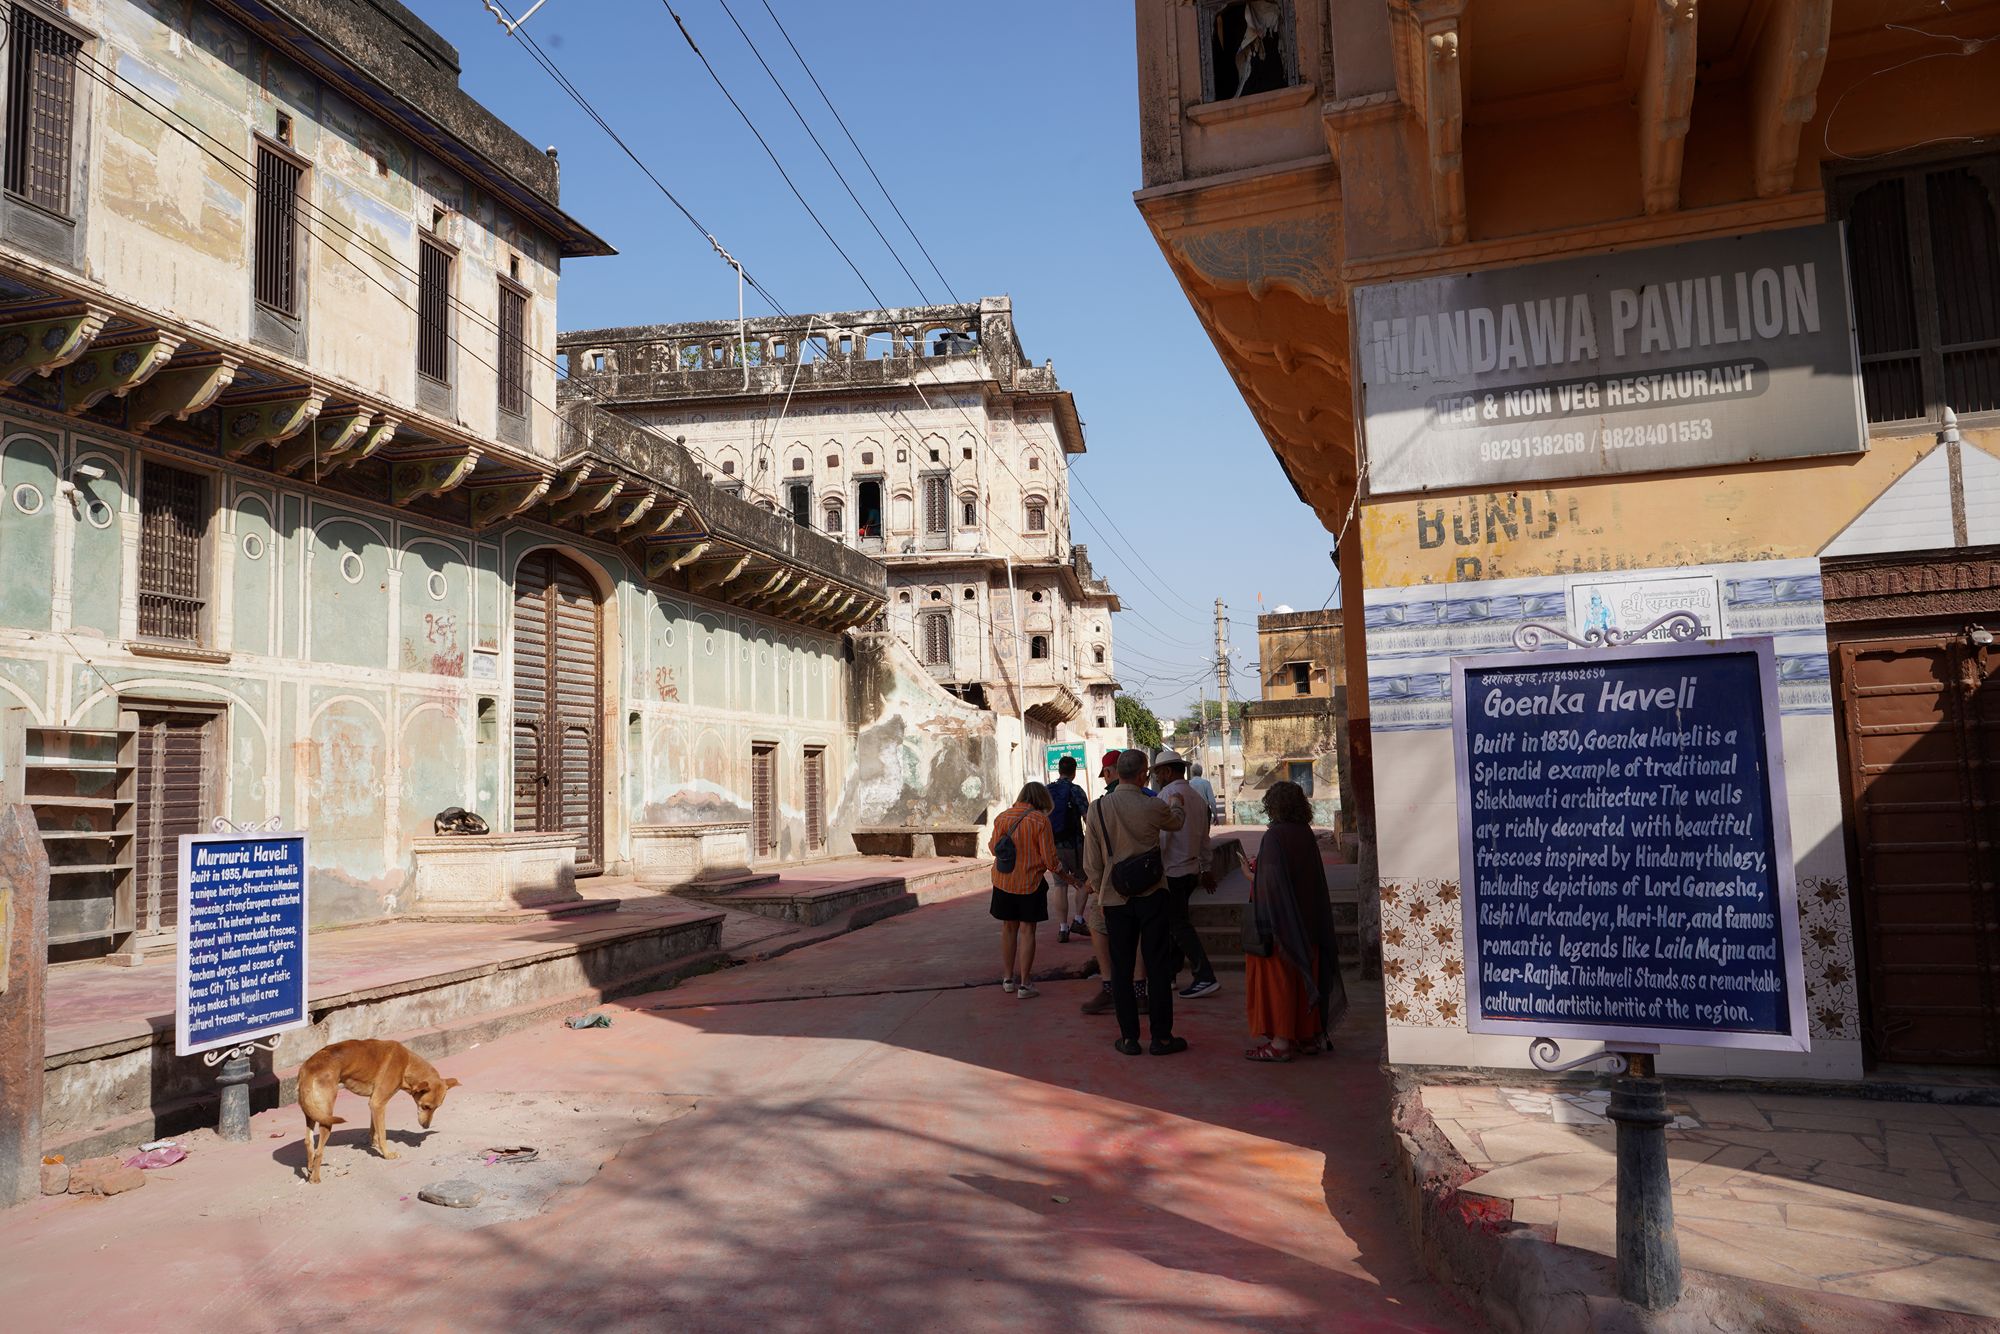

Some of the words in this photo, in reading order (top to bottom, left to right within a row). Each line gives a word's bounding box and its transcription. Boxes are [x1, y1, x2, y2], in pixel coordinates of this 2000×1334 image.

[1373, 293, 1599, 385] MANDAWA
[1610, 262, 1821, 357] PAVILION
[1436, 396, 1477, 425] VEG
[1482, 393, 1499, 420] &
[1505, 388, 1552, 418] NON
[1557, 382, 1600, 412] VEG
[1606, 363, 1754, 407] RESTAURANT
[1480, 432, 1586, 463] 9829138268
[1601, 418, 1713, 450] 9828401553
[1484, 684, 1585, 718] Goenka
[1598, 676, 1697, 713] Haveli
[1474, 732, 1515, 754] Built
[1522, 732, 1538, 752] in
[1650, 724, 1703, 748] Haveli
[1705, 724, 1721, 747] is
[1725, 729, 1738, 745] a
[1474, 760, 1542, 786] Splendid
[1548, 758, 1621, 783] example
[1624, 756, 1643, 777] of
[1644, 753, 1737, 777] traditional
[1475, 787, 1558, 810] Shekhawati
[1560, 785, 1657, 809] architecture
[1660, 784, 1688, 806] The
[1696, 783, 1742, 806] walls
[1476, 823, 1500, 839] are
[1505, 816, 1548, 843] richly
[1551, 814, 1625, 837] decorated
[1631, 813, 1671, 837] with
[1675, 812, 1752, 837] beautiful
[196, 847, 250, 867] Murmuria
[253, 844, 288, 862] Haveli
[1477, 845, 1542, 868] frescoes
[1544, 844, 1609, 872] inspired
[1612, 844, 1631, 871] by
[1635, 843, 1679, 868] Hindu
[1680, 843, 1766, 873] mythology,
[190, 870, 211, 884] Built
[212, 870, 220, 881] in
[221, 868, 241, 882] 1935,
[242, 867, 273, 880] Murmuria
[274, 864, 292, 877] Haveli
[292, 866, 298, 876] is
[1480, 873, 1540, 900] including
[1542, 873, 1618, 902] depictions
[1622, 874, 1641, 897] of
[1644, 874, 1681, 897] Lord
[1682, 874, 1764, 902] Ganesha,
[195, 887, 217, 901] unique
[243, 881, 273, 895] Structure
[189, 902, 224, 917] Showcasing
[225, 900, 246, 913] strong
[246, 898, 271, 911] European
[218, 917, 231, 929] The
[230, 914, 253, 927] interior
[254, 912, 270, 924] walls
[270, 912, 281, 922] are
[1480, 902, 1514, 926] Rishi
[1515, 902, 1615, 932] Markandeya,
[1691, 904, 1722, 930] and
[1724, 904, 1775, 930] famous
[189, 934, 215, 949] adorned
[217, 931, 232, 945] with
[234, 927, 269, 942] remarkable
[269, 925, 297, 938] frescoes,
[222, 947, 240, 960] Indian
[241, 943, 268, 957] freedom
[268, 939, 296, 954] fighters,
[1482, 933, 1552, 957] romantic
[1559, 933, 1618, 963] legends
[1622, 935, 1650, 960] like
[1654, 935, 1693, 960] Laila
[1695, 936, 1745, 967] Majnu
[1747, 937, 1776, 961] and
[189, 968, 216, 981] Pancham
[239, 960, 251, 972] and
[252, 958, 275, 971] scenes
[276, 954, 284, 967] of
[1570, 964, 1597, 987] This
[1597, 965, 1632, 989] Haveli
[1699, 974, 1707, 990] a
[1710, 969, 1781, 993] remarkable
[189, 986, 208, 1000] Venus
[210, 982, 224, 996] City
[225, 979, 240, 992] This
[241, 975, 258, 988] blend
[260, 973, 268, 984] of
[267, 970, 291, 983] artistic
[189, 1001, 206, 1017] styles
[207, 998, 229, 1011] makes
[229, 994, 240, 1007] the
[241, 989, 260, 1004] Haveli
[265, 988, 279, 998] rare
[1485, 990, 1533, 1013] cultural
[1535, 994, 1556, 1015] and
[1556, 995, 1602, 1017] artistic
[1604, 997, 1646, 1018] heritic
[1648, 997, 1663, 1018] of
[1665, 998, 1689, 1020] the
[1695, 999, 1754, 1024] region.
[189, 1015, 214, 1033] cultural
[215, 1012, 248, 1027] treasure.
